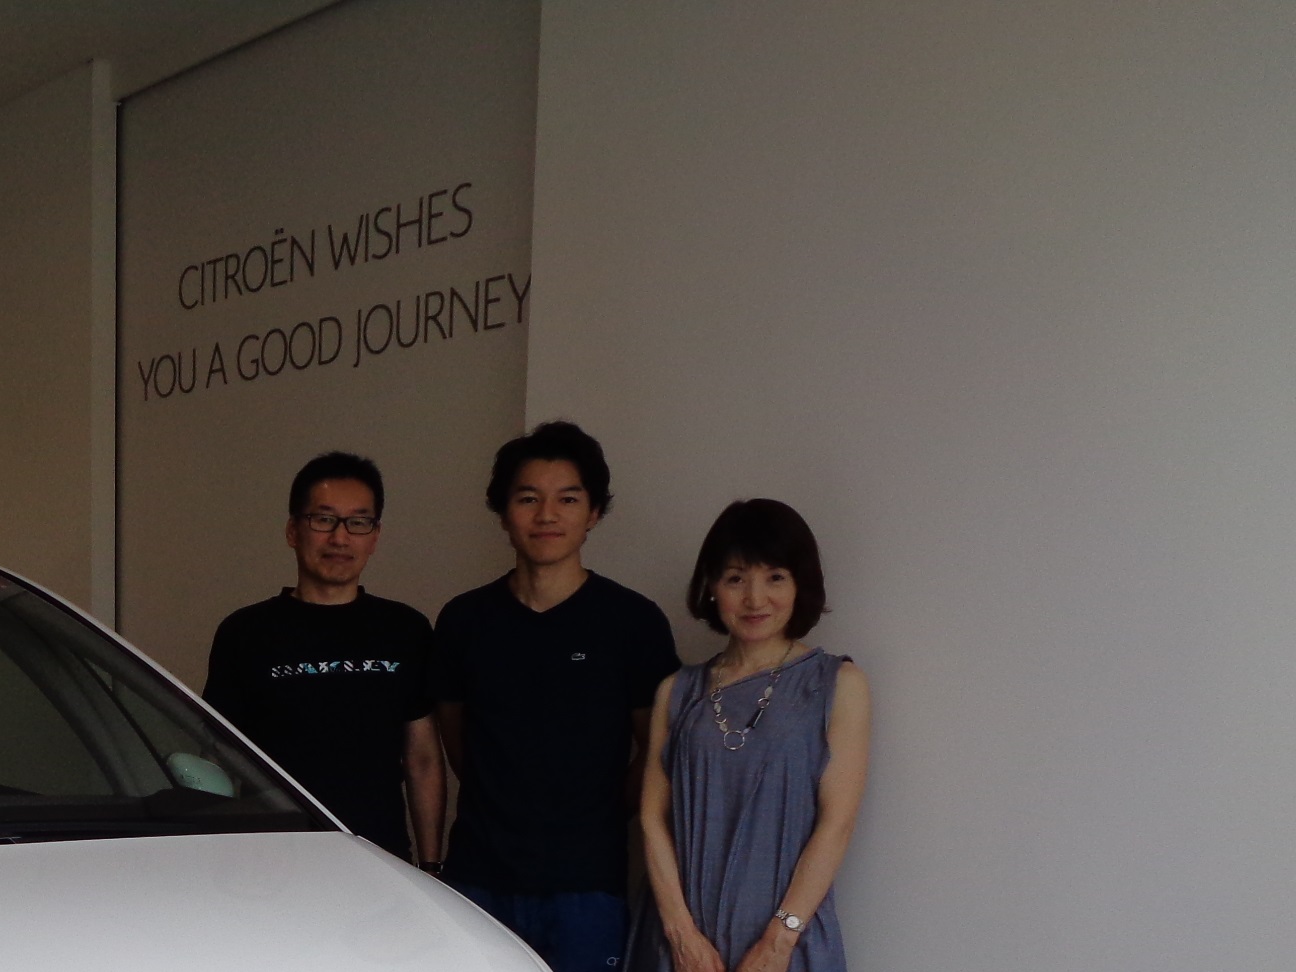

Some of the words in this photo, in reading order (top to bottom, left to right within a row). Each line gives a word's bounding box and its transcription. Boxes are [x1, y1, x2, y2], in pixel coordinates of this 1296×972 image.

[178, 227, 316, 310] CITROËN
[328, 182, 474, 270] WISHES
[137, 347, 197, 401] YOU
[206, 341, 228, 389] A
[237, 316, 343, 381] GOOD
[353, 272, 532, 368] JOURNEY
